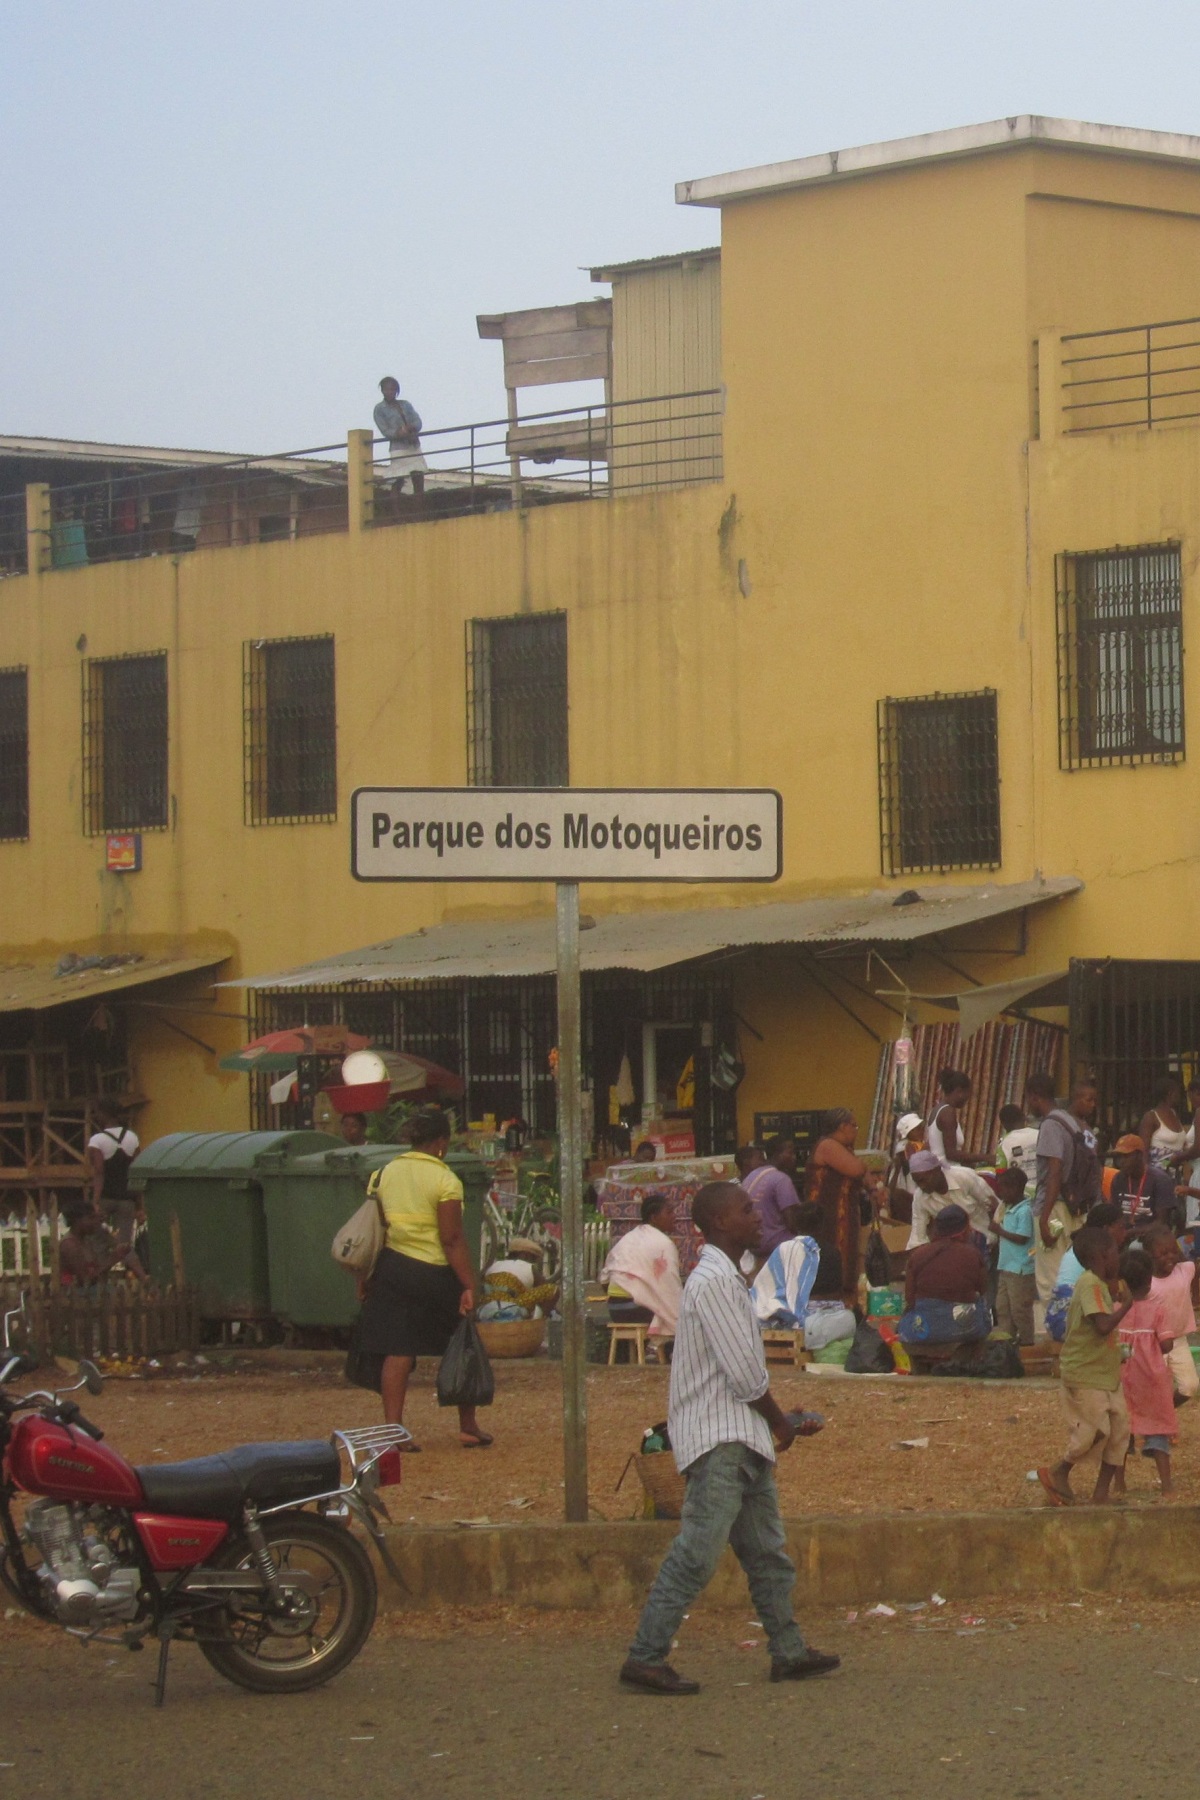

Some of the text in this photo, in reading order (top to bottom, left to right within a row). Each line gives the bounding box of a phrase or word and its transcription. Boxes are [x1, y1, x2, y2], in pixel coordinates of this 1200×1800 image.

[372, 812, 763, 859] Parque dos Motoqueiros
